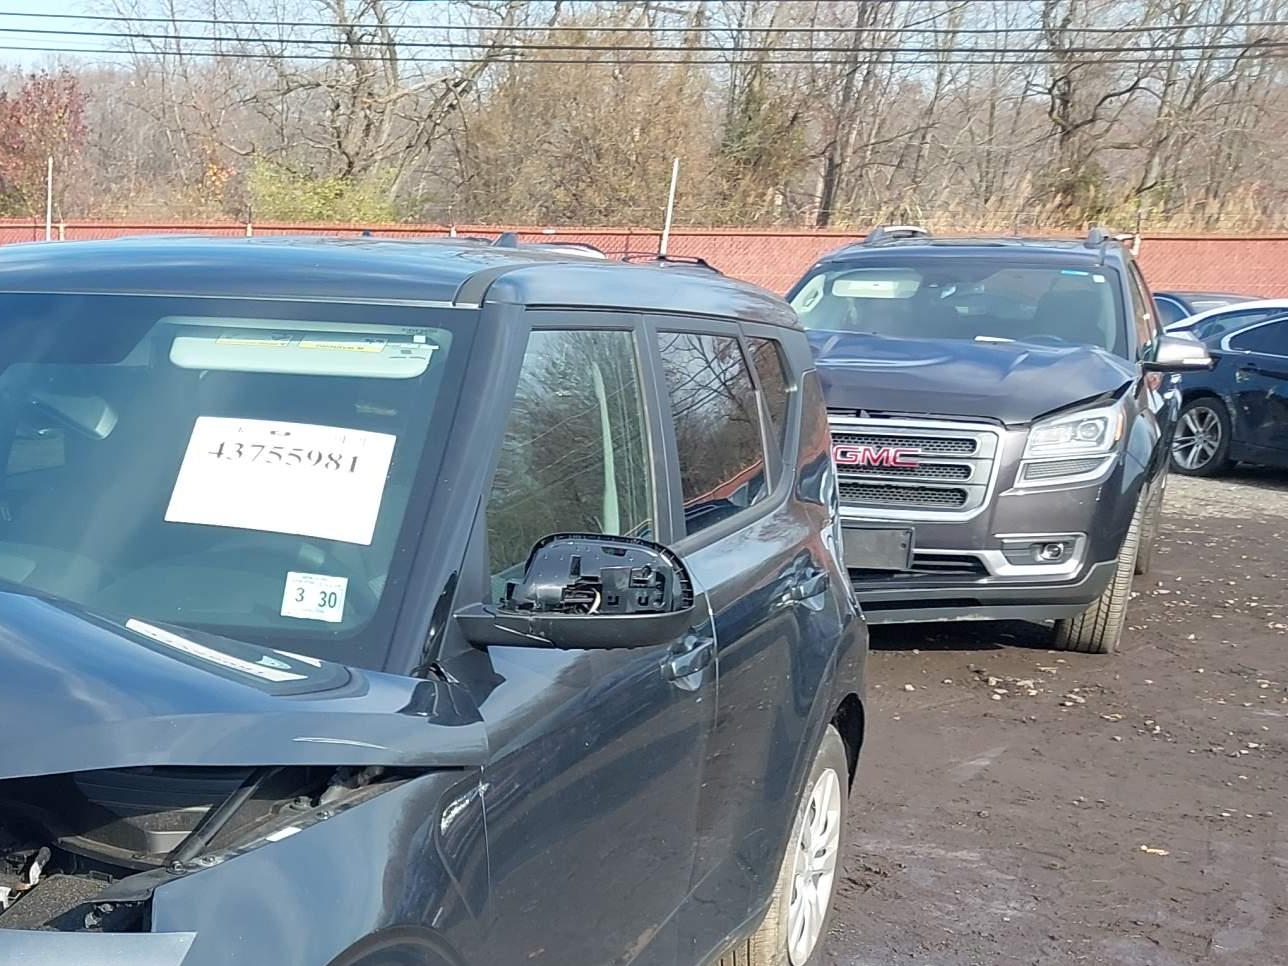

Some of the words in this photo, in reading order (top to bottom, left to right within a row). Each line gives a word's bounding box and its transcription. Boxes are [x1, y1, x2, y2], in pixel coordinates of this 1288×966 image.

[833, 445, 921, 468] GMC
[294, 587, 305, 602] 3
[318, 590, 337, 608] 30
